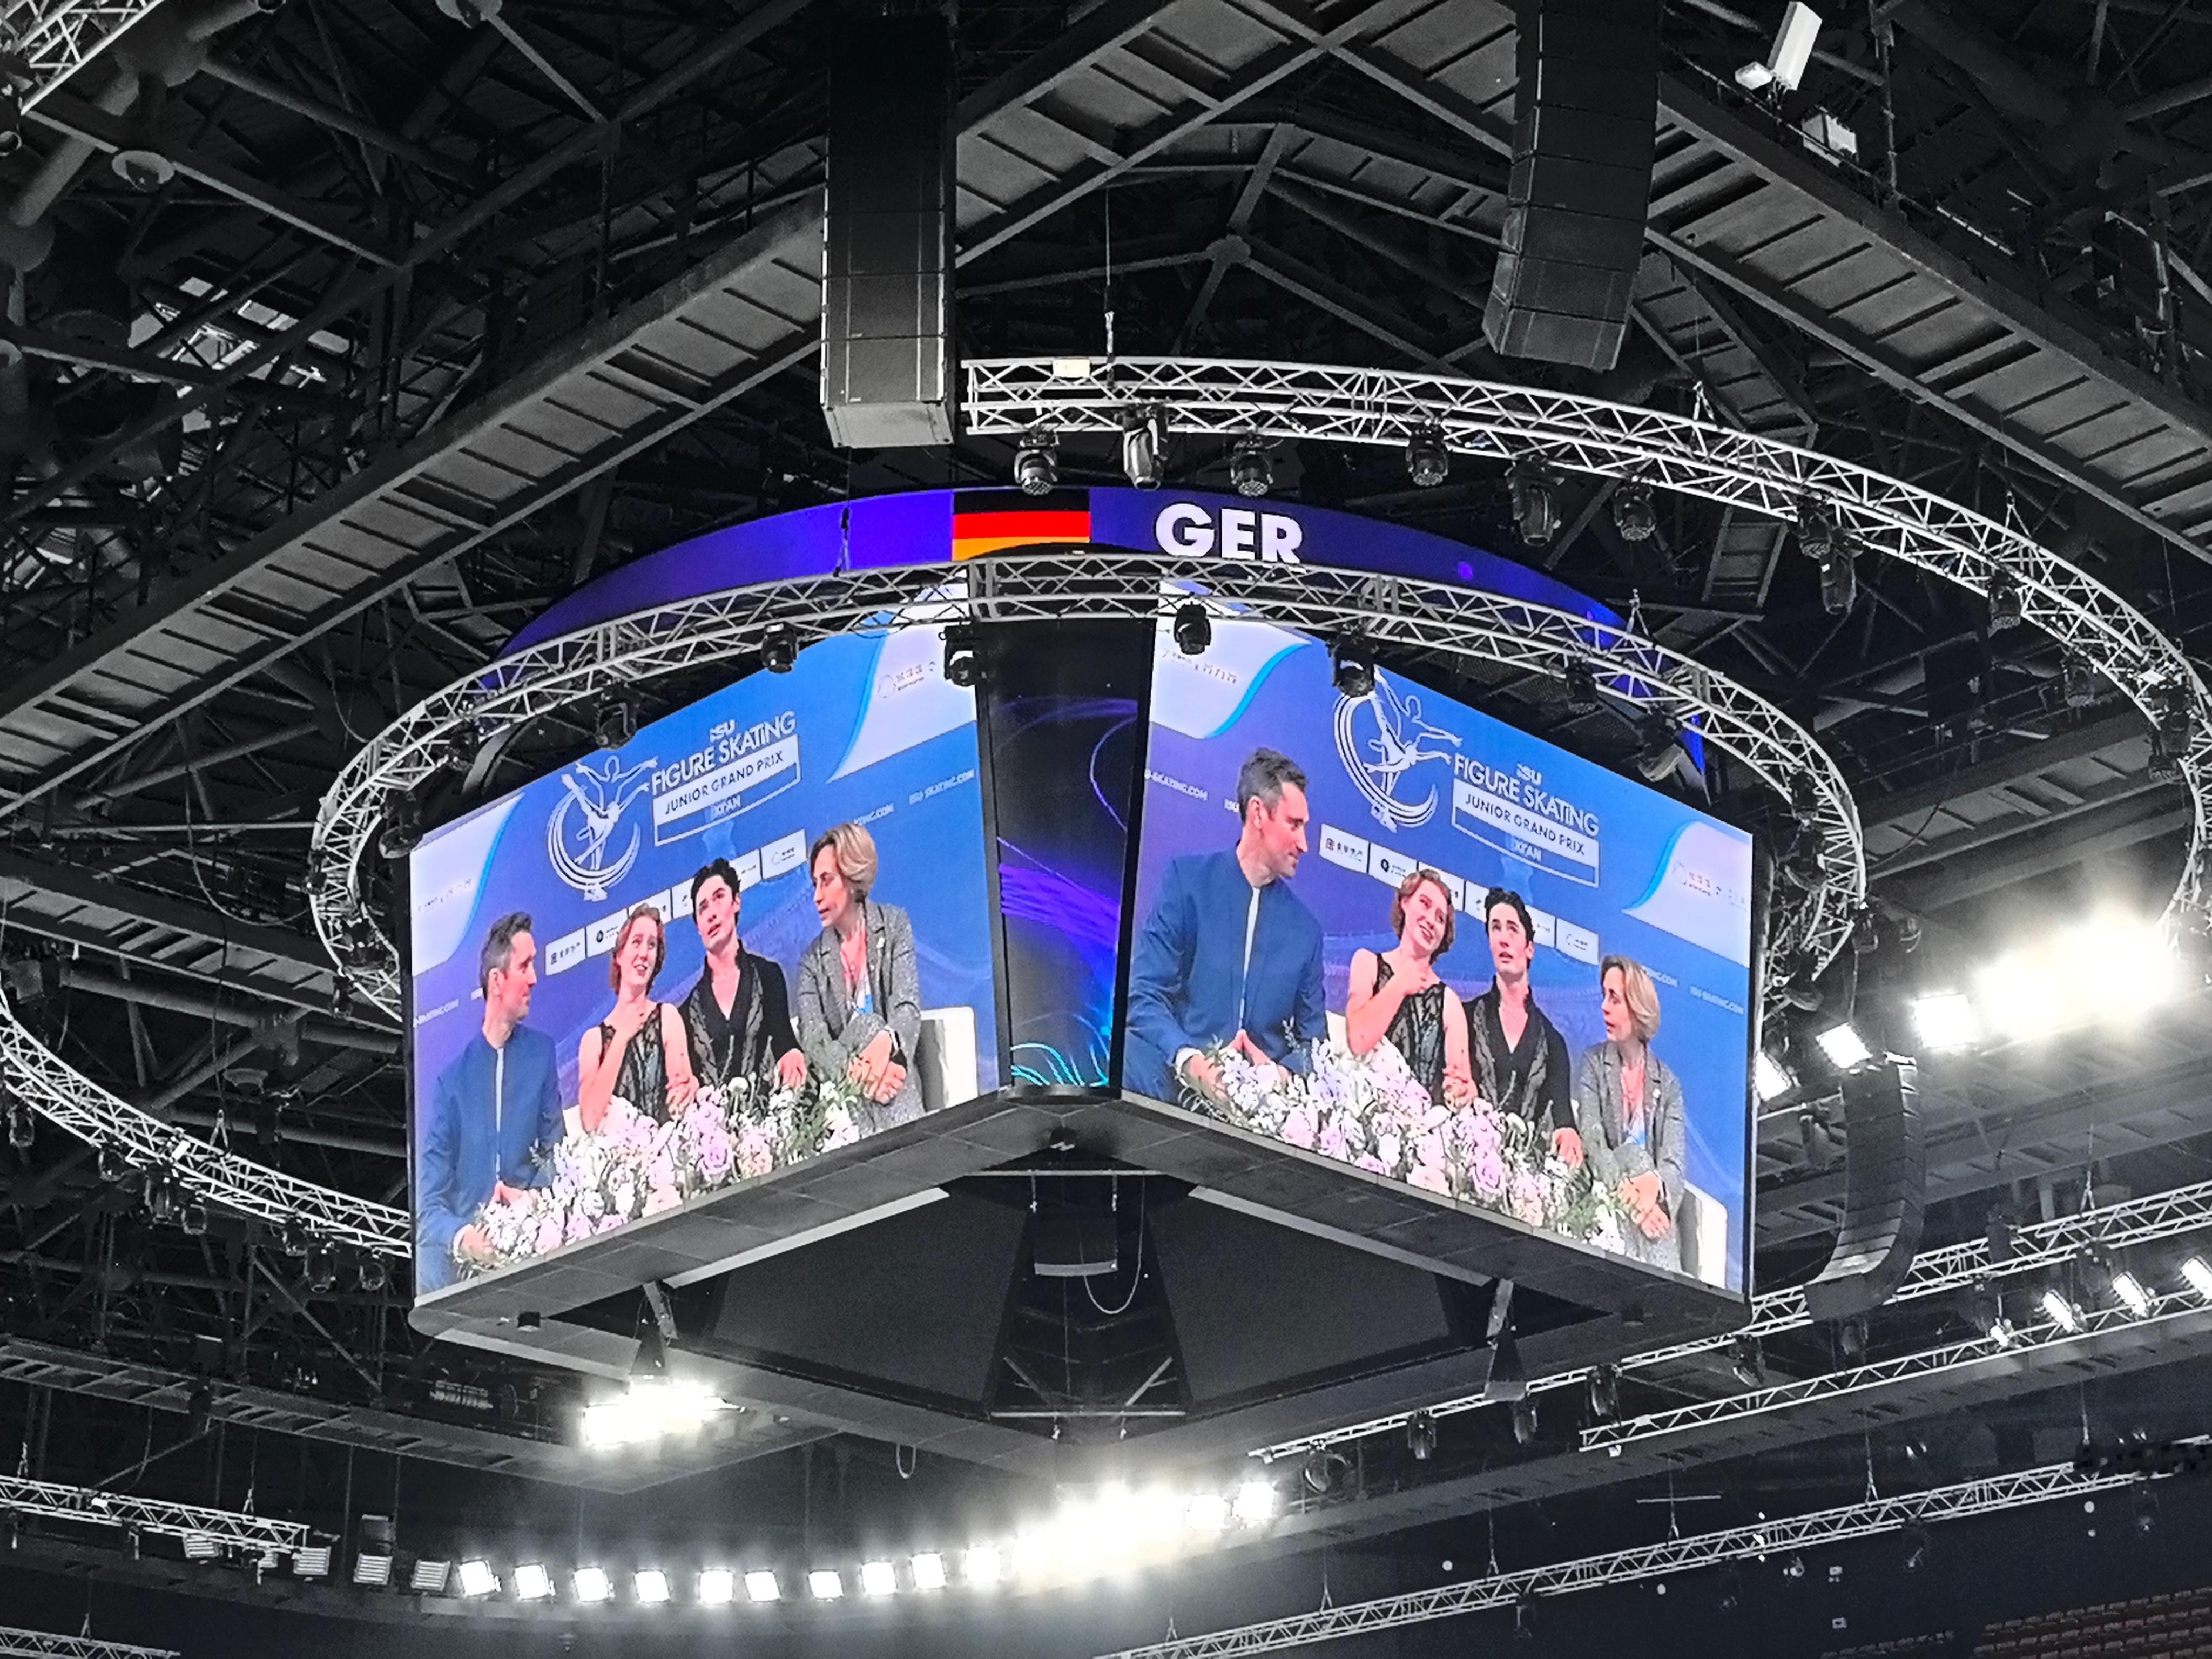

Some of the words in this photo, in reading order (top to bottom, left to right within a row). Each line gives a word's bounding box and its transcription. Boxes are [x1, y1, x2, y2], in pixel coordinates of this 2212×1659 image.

[1155, 503, 1304, 565] GER
[652, 746, 716, 796] FIGURE
[719, 711, 796, 763] SKATING
[665, 785, 708, 814] JUNIOR
[711, 764, 754, 792] GRAND
[757, 750, 784, 772] PRIX
[1454, 752, 1520, 802] FIGURE
[1523, 785, 1599, 837] SKATING
[1466, 793, 1511, 823] JUNIOR
[1514, 814, 1556, 841] GRAND
[1559, 834, 1585, 855] PRIX
